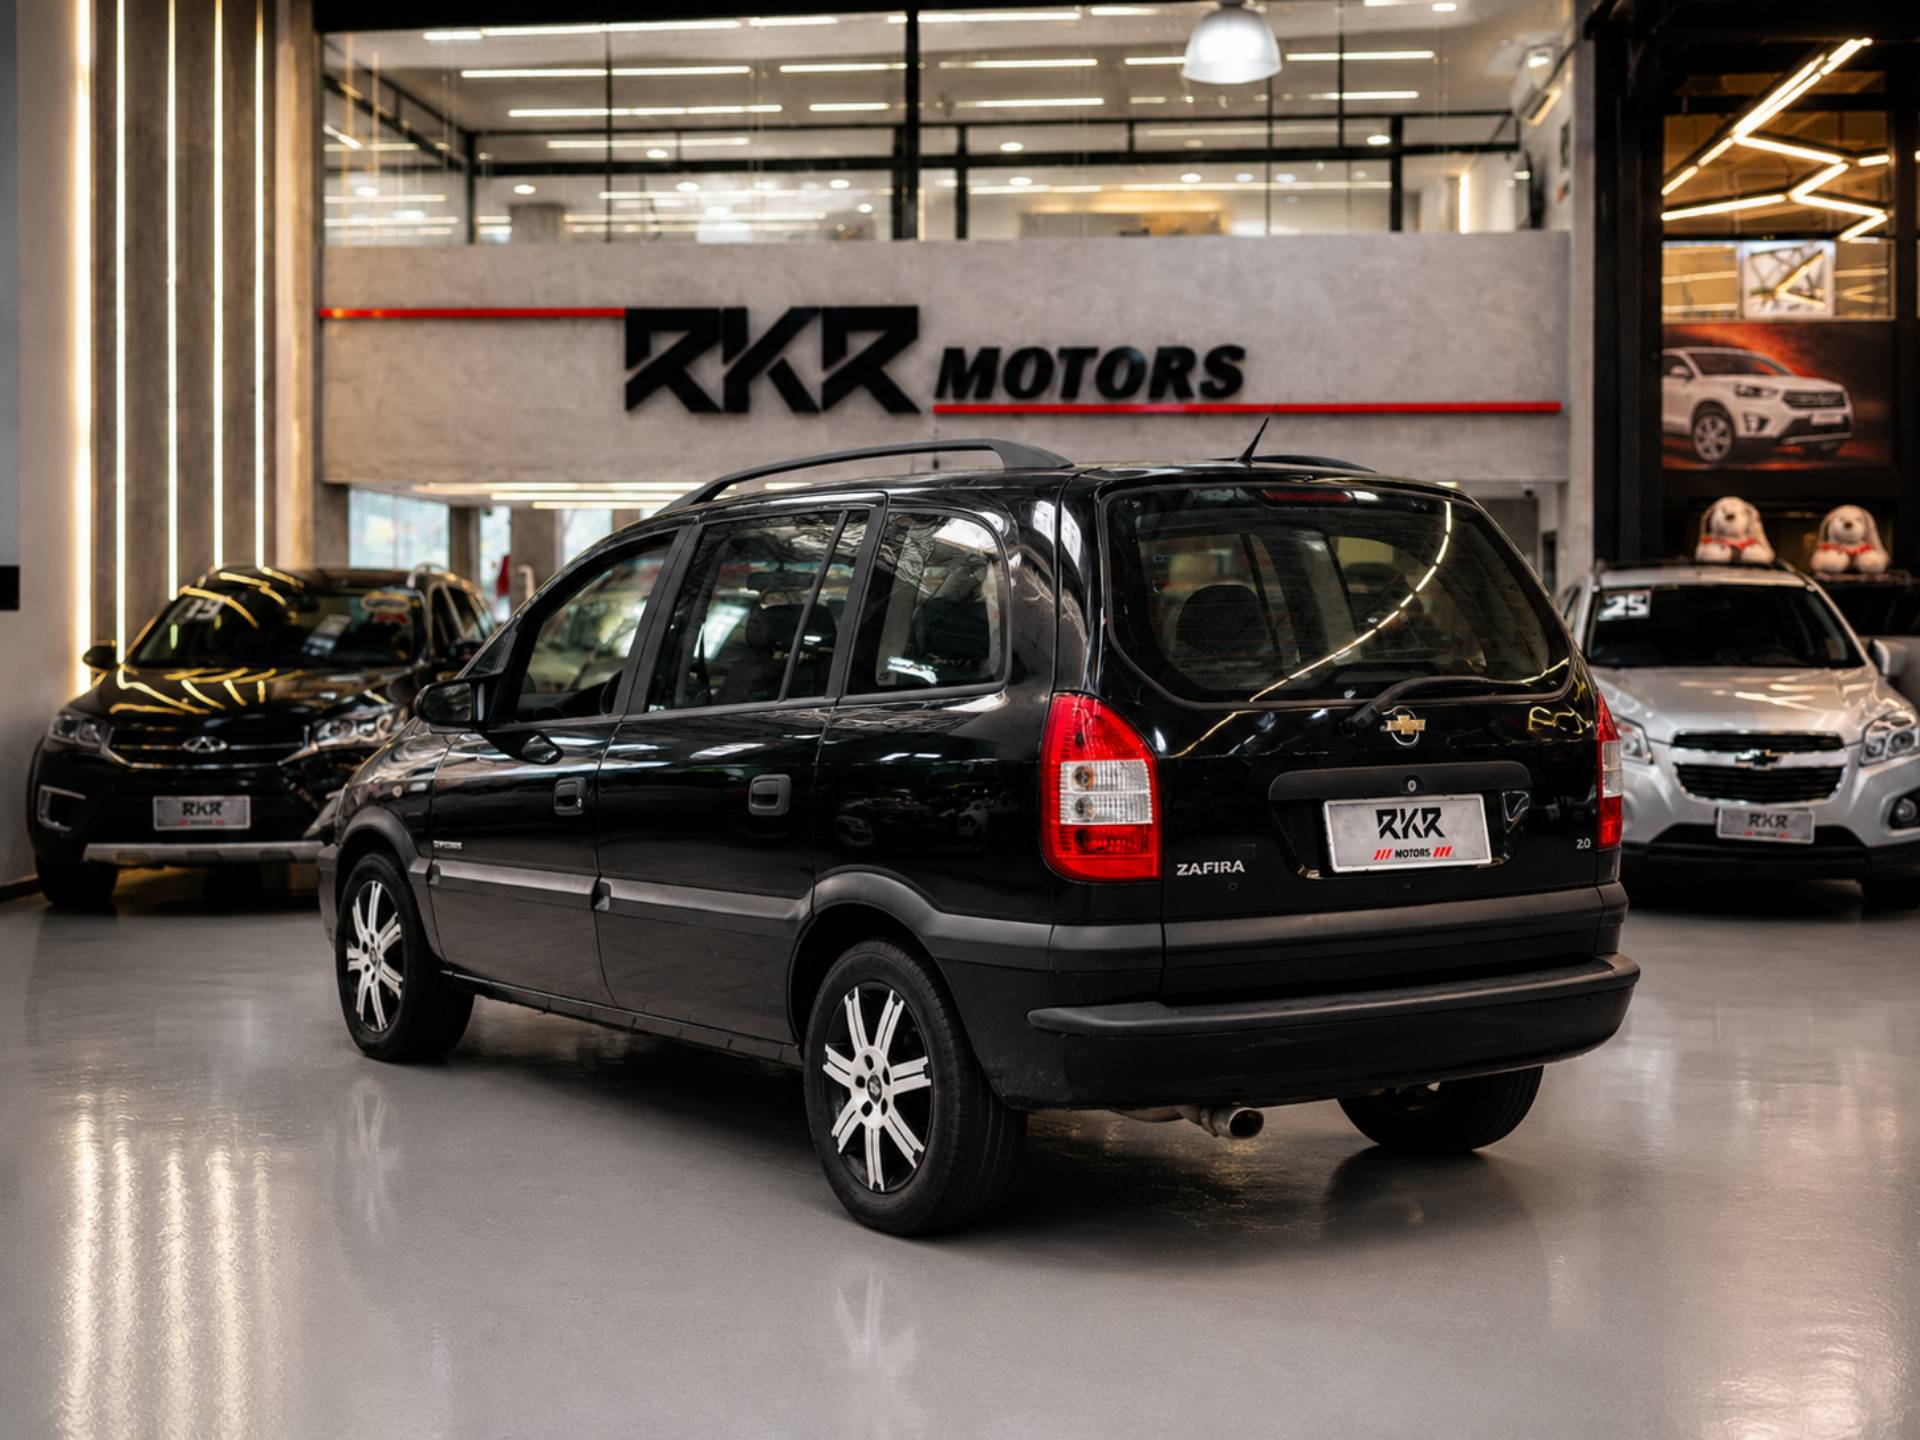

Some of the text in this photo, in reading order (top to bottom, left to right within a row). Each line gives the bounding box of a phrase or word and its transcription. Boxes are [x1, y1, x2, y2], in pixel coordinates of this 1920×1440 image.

[625, 306, 1246, 413] RKR MOTORS
[1602, 593, 1649, 617] 25
[182, 801, 222, 816] RKR
[1376, 807, 1445, 839] RKR
[1748, 813, 1788, 828] RKR
[1395, 848, 1431, 858] MOTORS
[1176, 859, 1246, 876] ZAFIRA
